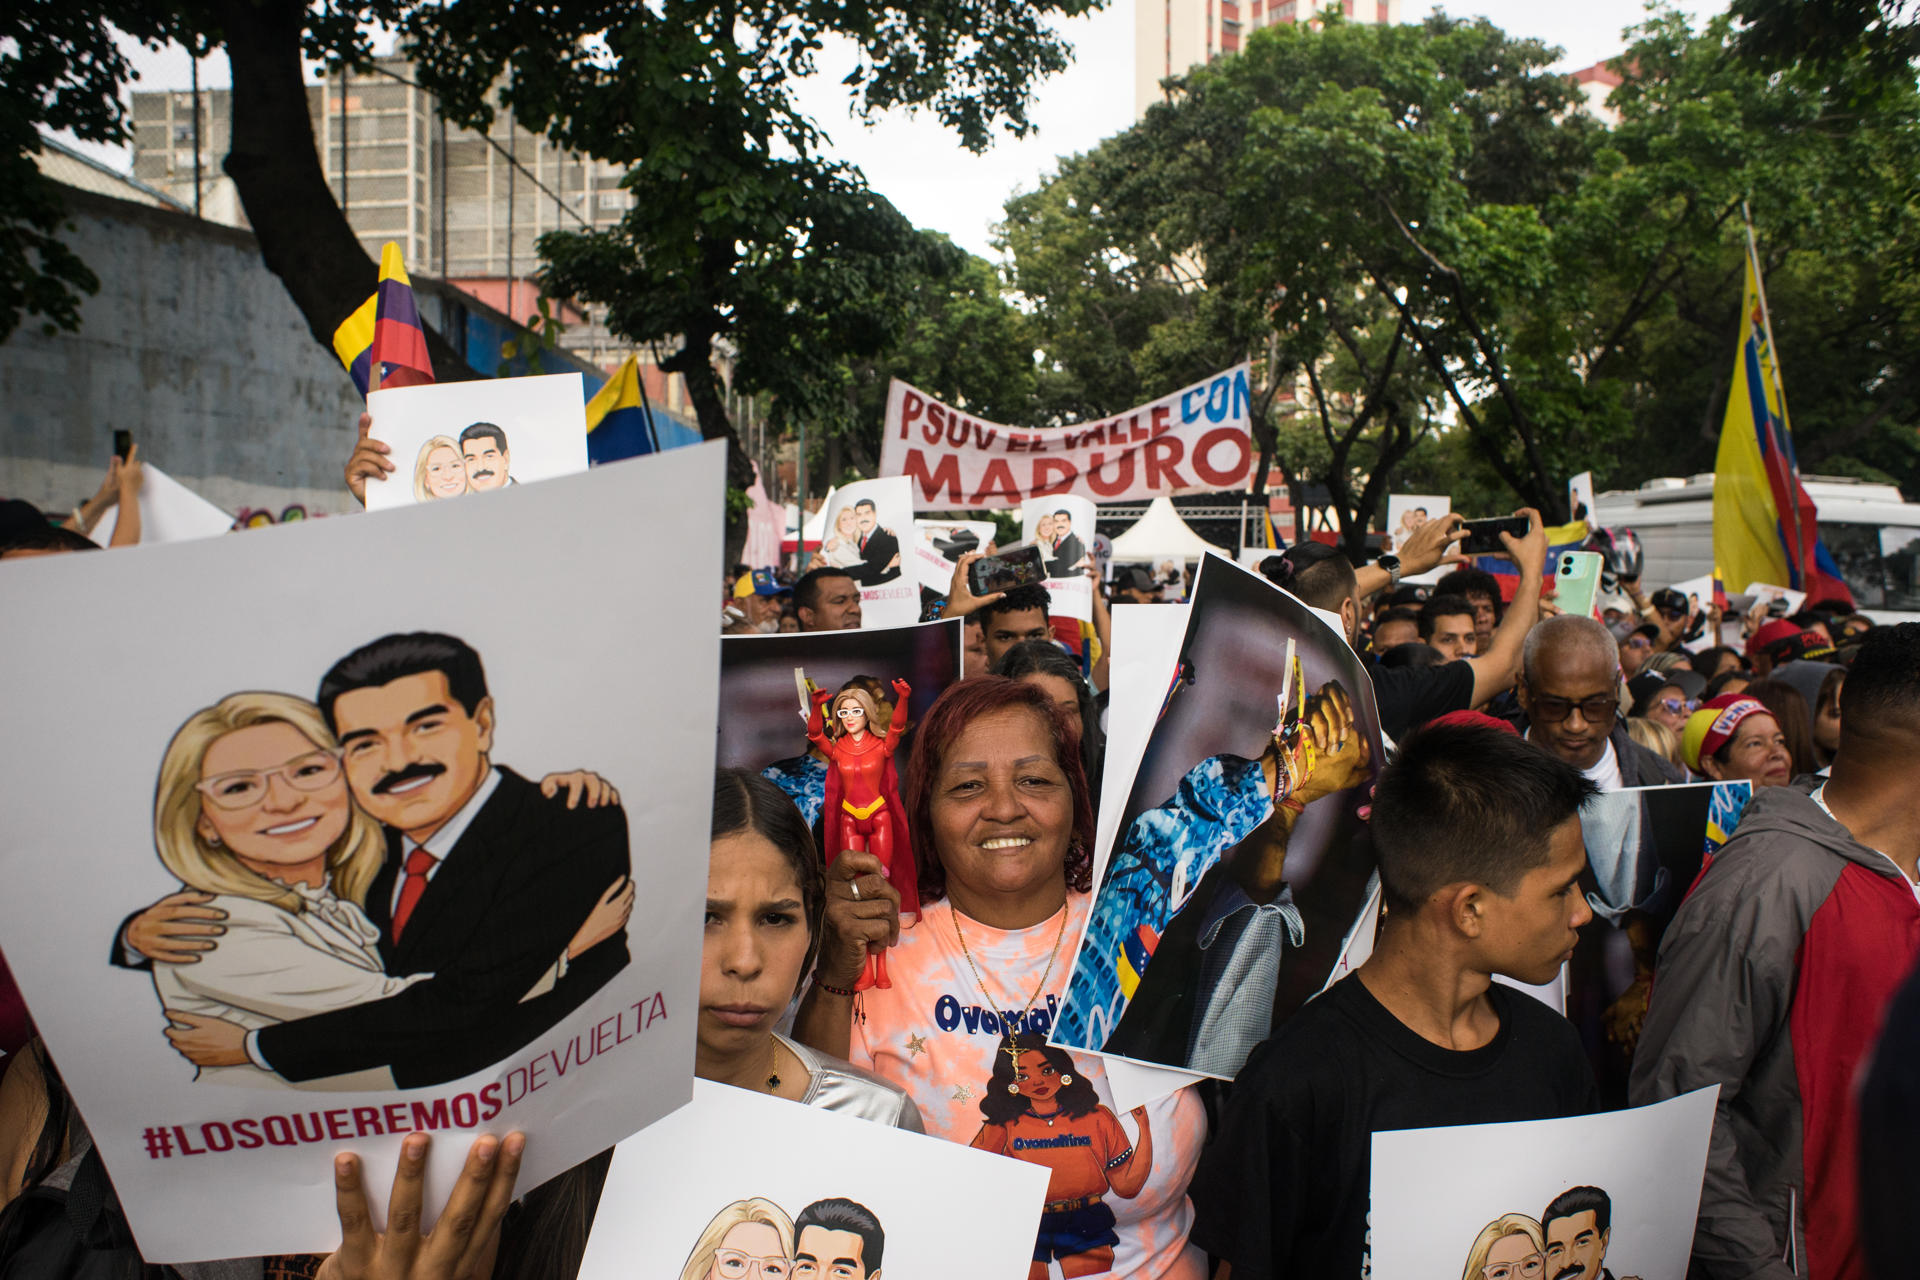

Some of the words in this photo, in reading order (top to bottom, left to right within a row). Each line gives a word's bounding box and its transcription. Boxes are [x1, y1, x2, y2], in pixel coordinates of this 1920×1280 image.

[899, 389, 998, 451] PSUV
[1006, 433, 1048, 453] EL
[1064, 405, 1171, 450] VALLE
[1181, 369, 1251, 425] CON
[902, 427, 1251, 505] MADURO
[934, 994, 1062, 1039] Ovomal
